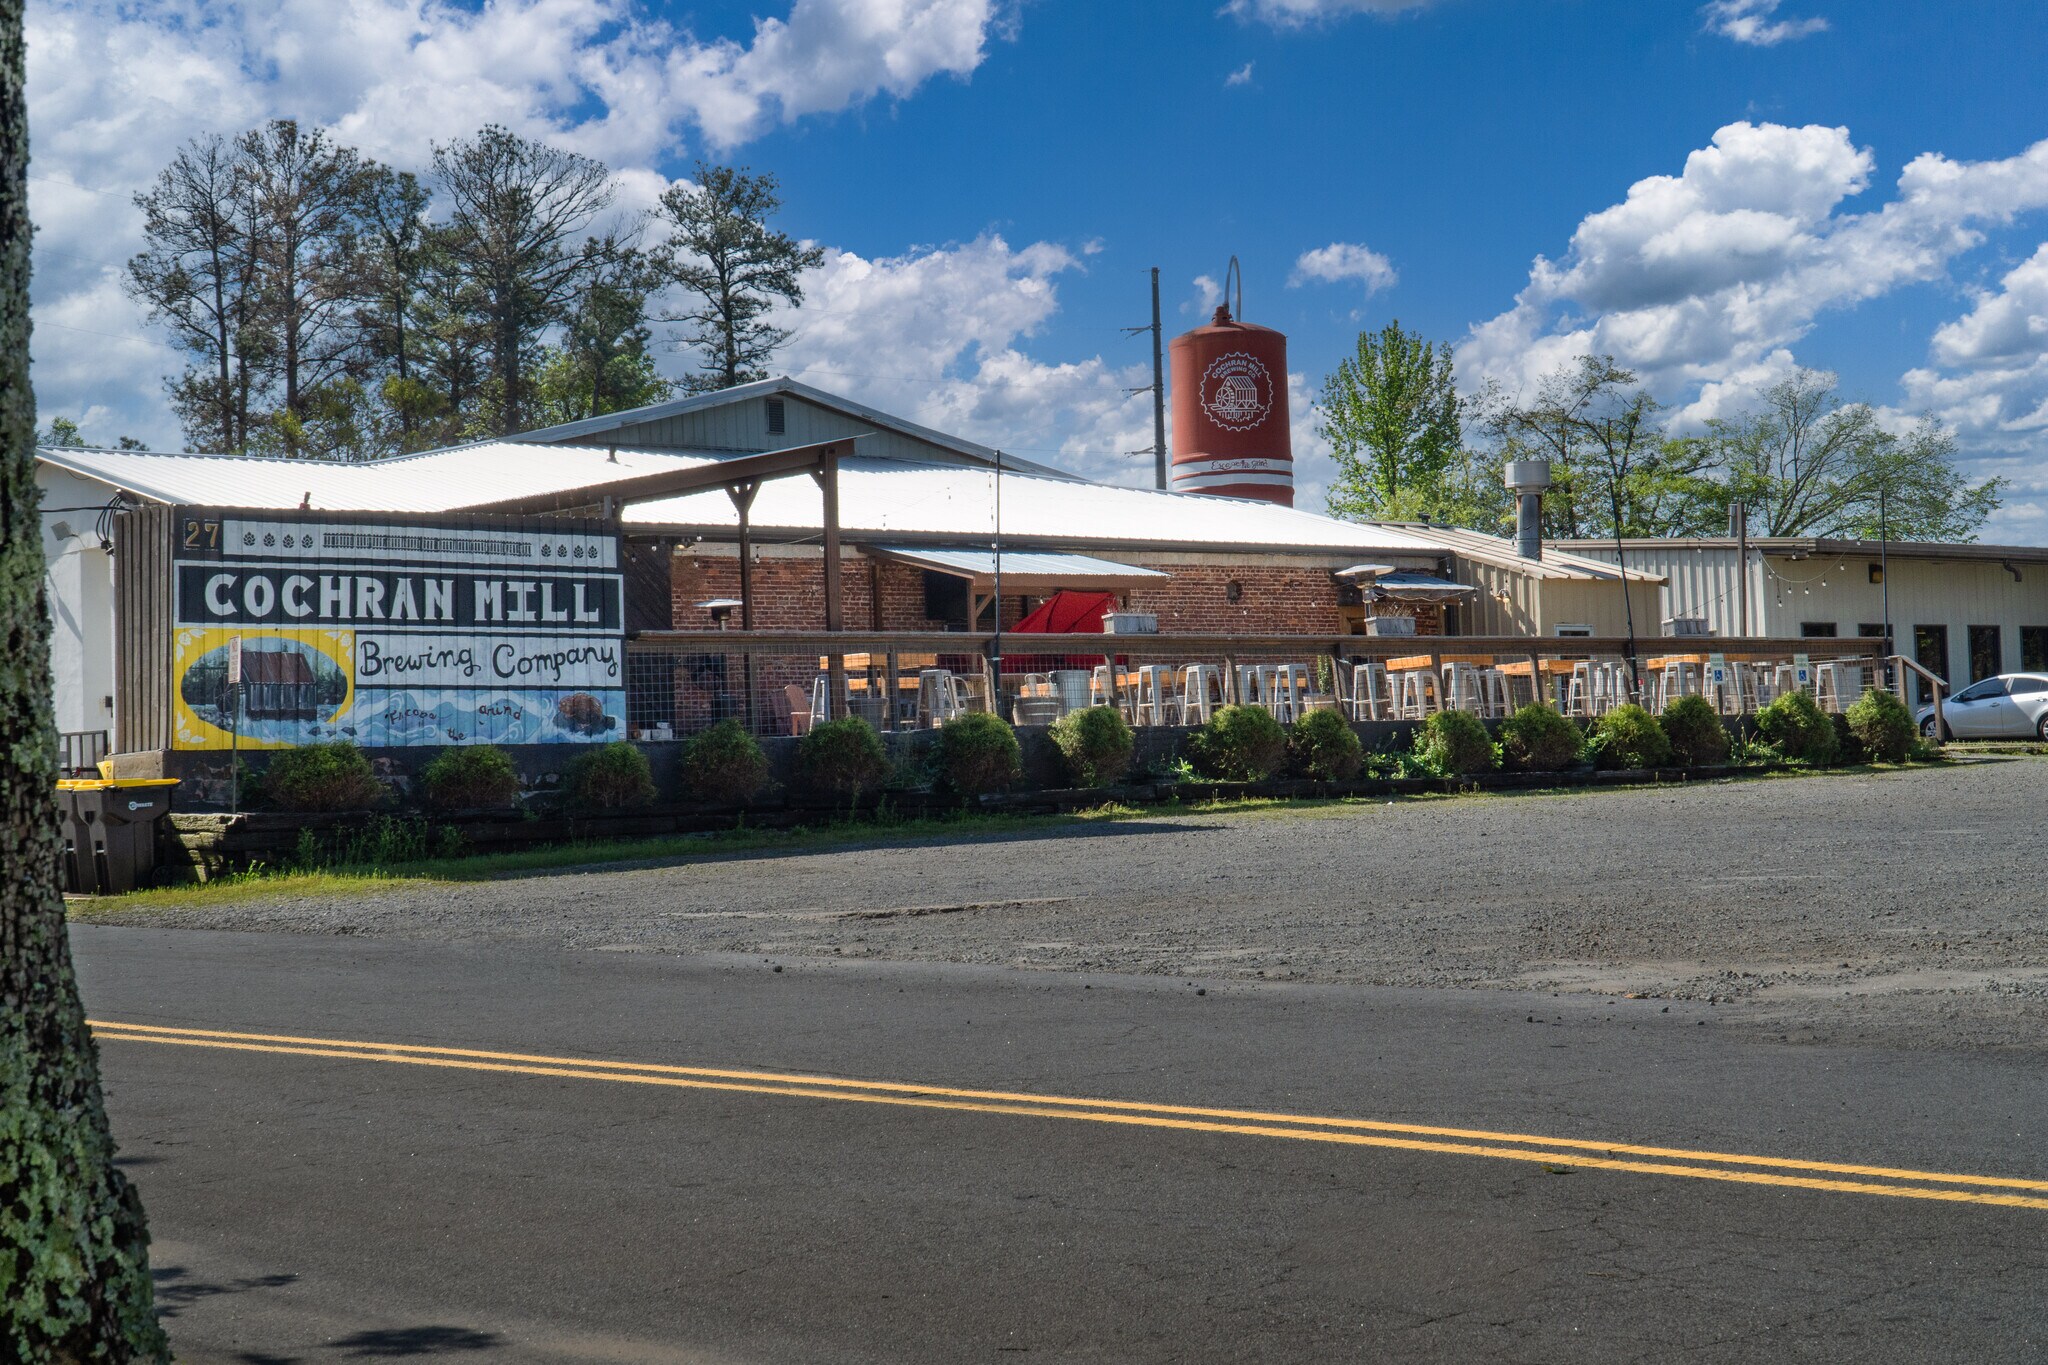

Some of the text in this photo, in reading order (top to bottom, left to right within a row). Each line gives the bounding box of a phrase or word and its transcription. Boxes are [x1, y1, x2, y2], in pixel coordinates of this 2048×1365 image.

[1212, 360, 1262, 379] COCHRAN MILL
[1220, 366, 1247, 379] BREWING
[185, 521, 219, 548] 27
[204, 573, 599, 622] COCHRAN MILL
[360, 640, 618, 682] Brewing Company
